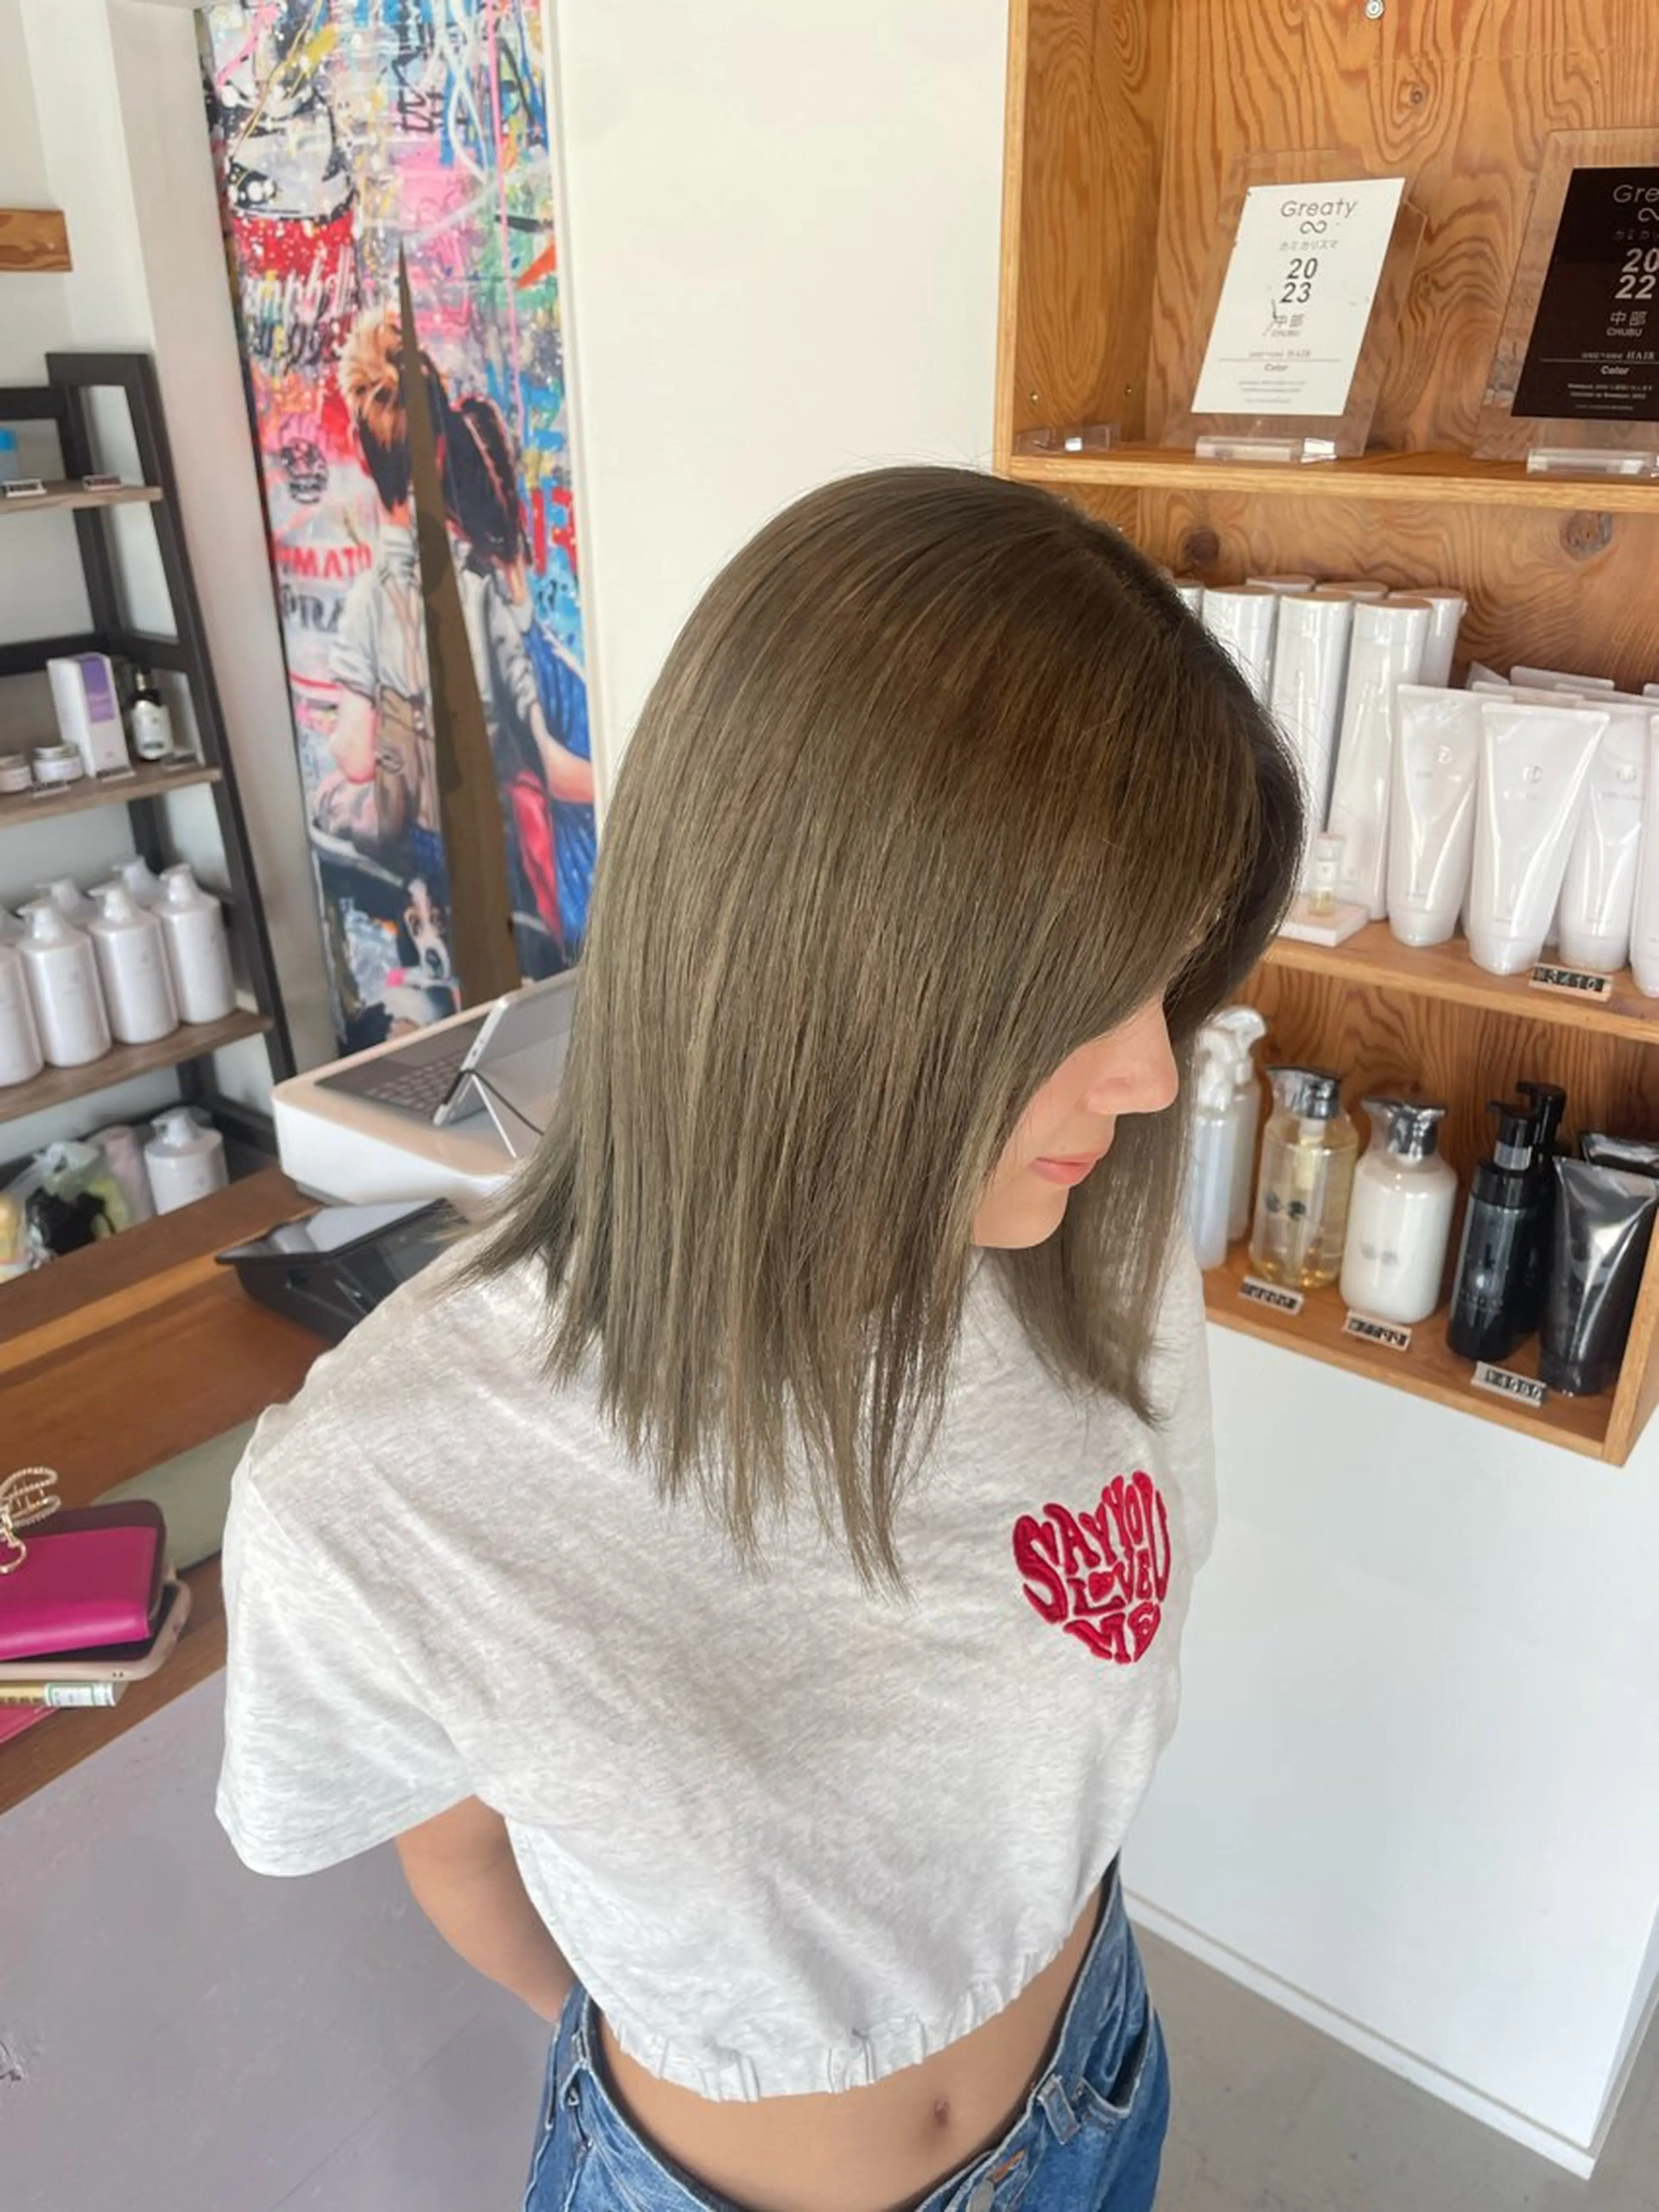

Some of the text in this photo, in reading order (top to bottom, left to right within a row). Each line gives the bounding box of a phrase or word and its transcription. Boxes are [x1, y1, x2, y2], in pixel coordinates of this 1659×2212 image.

[1281, 198, 1358, 219] Greaty
[1287, 257, 1318, 279] 20
[1621, 248, 1659, 273] 20
[1280, 282, 1312, 303] 23
[1615, 274, 1656, 299] 22
[1610, 311, 1647, 326] 中部
